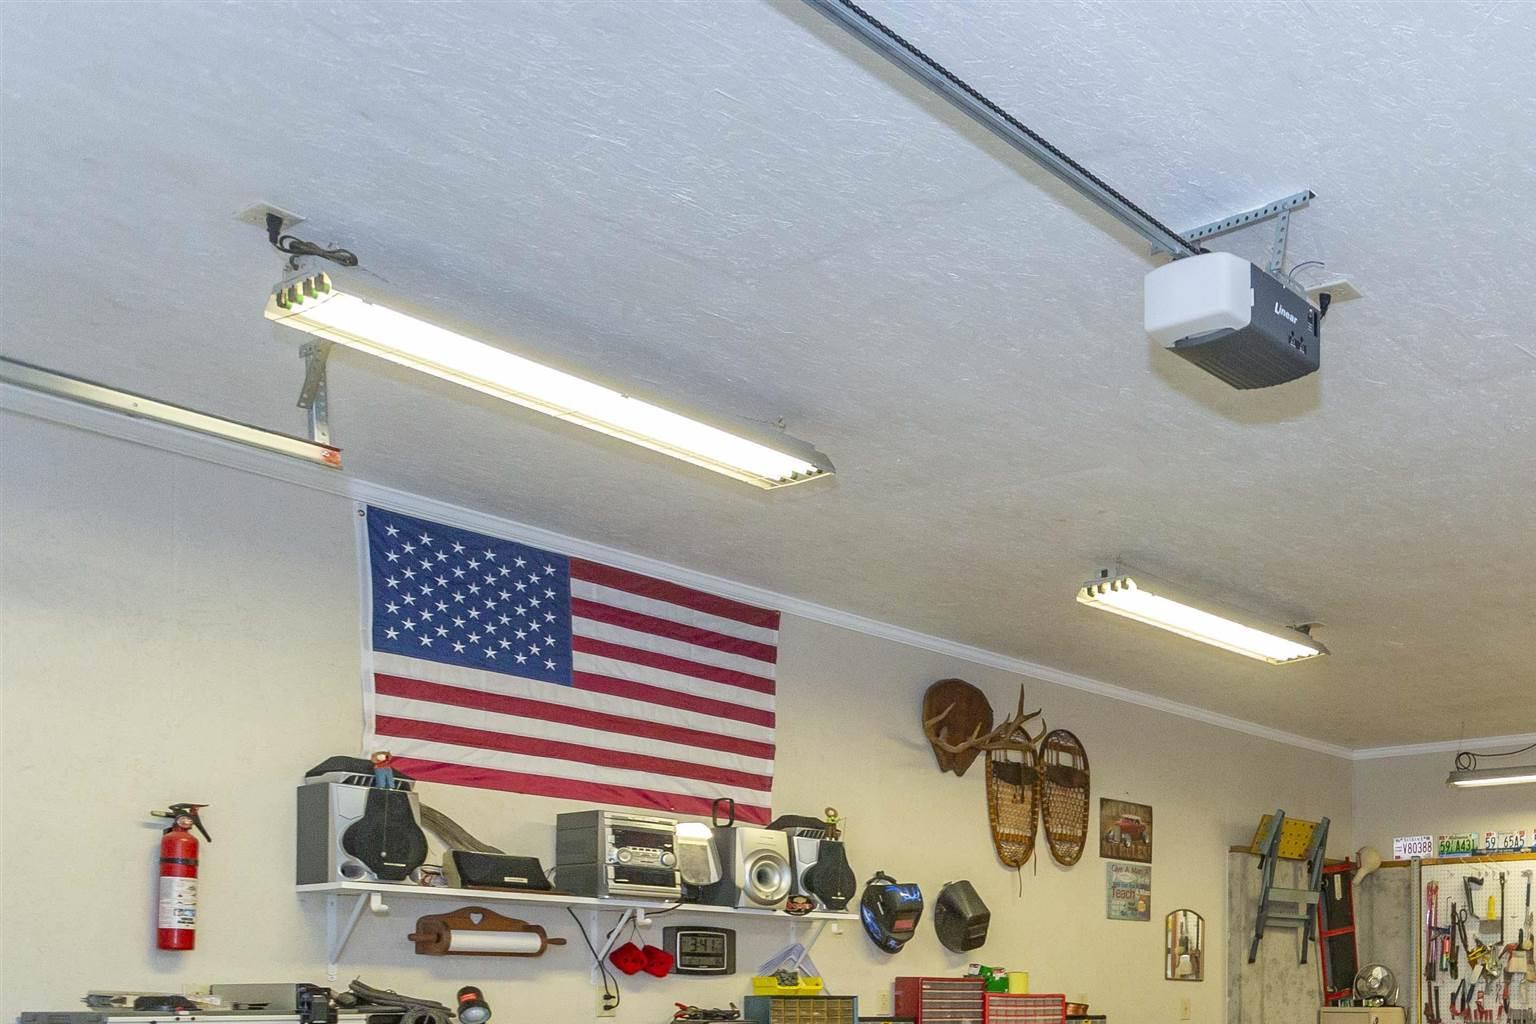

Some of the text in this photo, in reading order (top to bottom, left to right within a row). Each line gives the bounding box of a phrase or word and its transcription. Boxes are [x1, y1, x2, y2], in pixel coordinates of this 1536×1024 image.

[1275, 301, 1298, 324] Linear
[1403, 841, 1432, 855] V80388
[1112, 885, 1136, 899] Teach
